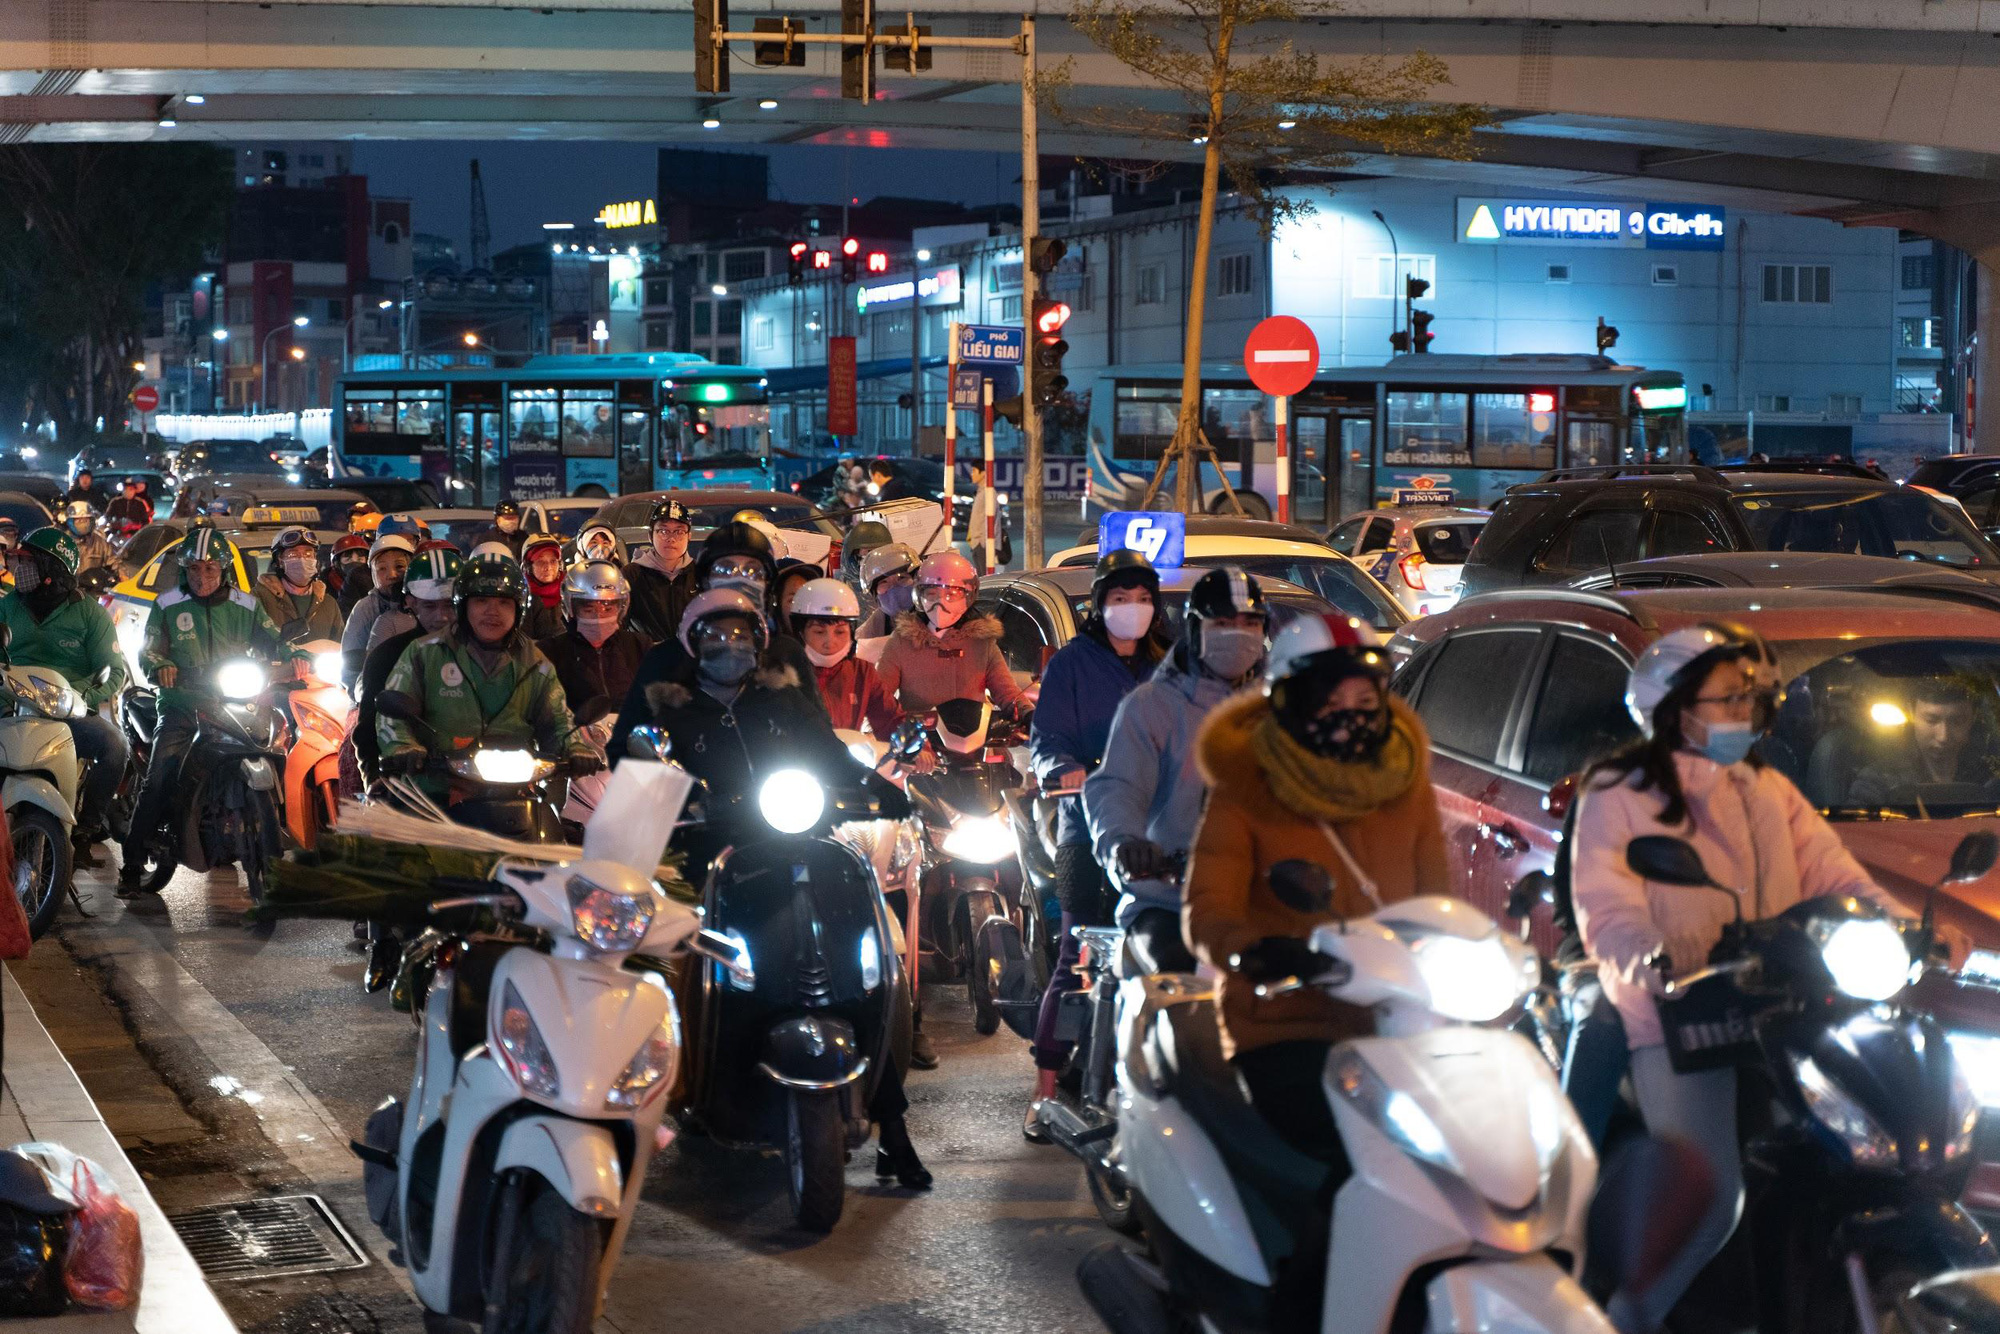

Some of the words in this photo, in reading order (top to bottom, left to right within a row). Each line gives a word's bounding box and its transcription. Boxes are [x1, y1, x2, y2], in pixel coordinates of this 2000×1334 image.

[605, 201, 641, 229] NAM
[1504, 206, 1620, 233] HYUNDAI
[989, 331, 1008, 341] PHỐ
[994, 345, 1019, 359] GIAI
[1124, 518, 1167, 563] G7
[56, 543, 75, 560] Grab
[478, 577, 506, 587] Grab
[177, 633, 197, 641] Grab
[59, 639, 80, 648] Grab
[439, 687, 464, 698] Grab
